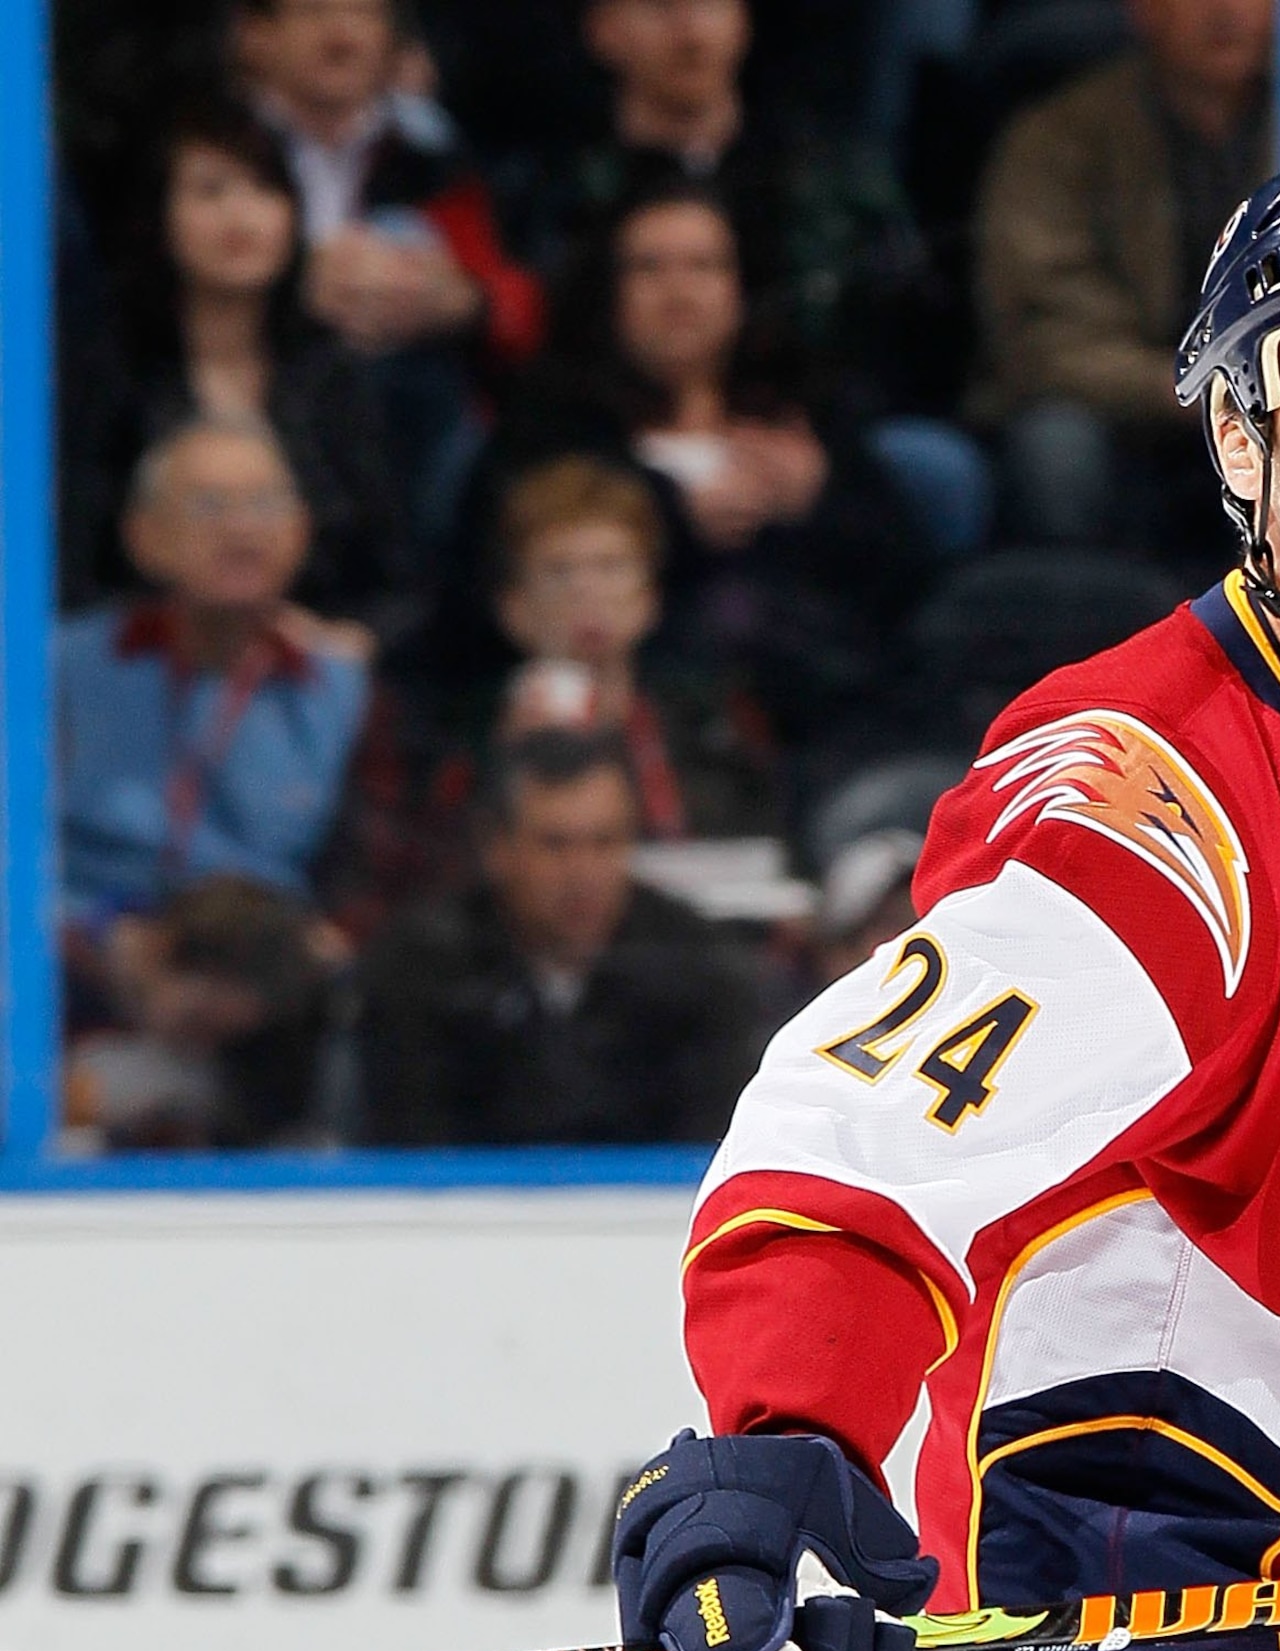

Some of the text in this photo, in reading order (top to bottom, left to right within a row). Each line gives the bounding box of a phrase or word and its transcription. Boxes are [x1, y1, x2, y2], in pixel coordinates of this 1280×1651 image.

[811, 930, 1041, 1136] 24
[0, 1468, 634, 1598] GESTO
[694, 1577, 732, 1648] Reebok
